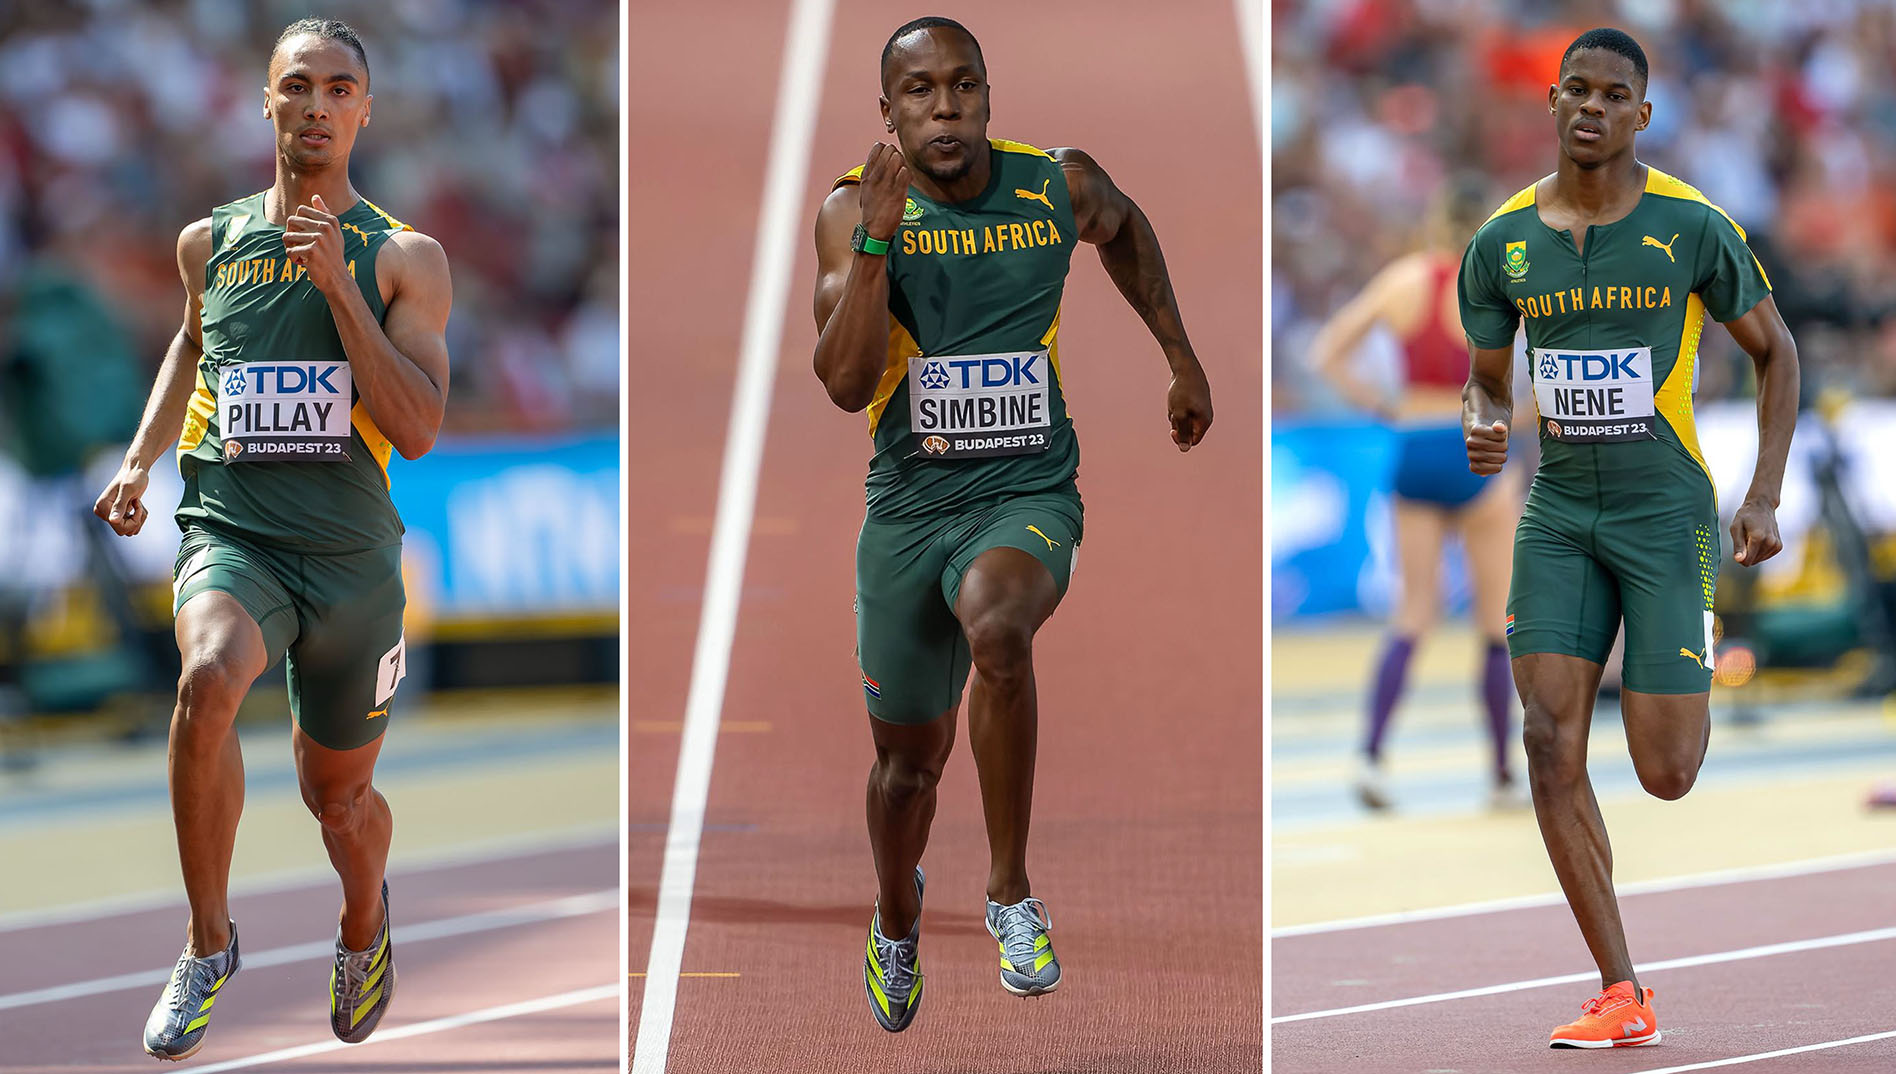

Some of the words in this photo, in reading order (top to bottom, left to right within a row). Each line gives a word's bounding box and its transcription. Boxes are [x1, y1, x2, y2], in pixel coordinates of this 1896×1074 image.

[902, 229, 977, 255] SOUTH
[983, 219, 1062, 253] AFRICA
[216, 258, 276, 290] SOUTH
[279, 257, 356, 282] AFA
[1515, 287, 1585, 319] SOUTH
[1590, 286, 1672, 309] AFRICA
[247, 366, 340, 394] TDK
[948, 355, 1040, 389] TDK
[1557, 352, 1641, 380] TDK
[920, 393, 1042, 430] SIMBINE
[1554, 387, 1625, 416] NENE
[228, 402, 334, 434] PILLAY
[1564, 424, 1630, 436] BUDAPEST
[1631, 422, 1648, 434] 23
[247, 442, 323, 454] BUDAPEST
[325, 442, 342, 454] 23
[954, 435, 1027, 451] BUDAPEST
[1029, 433, 1045, 446] 23
[389, 646, 401, 690] 7
